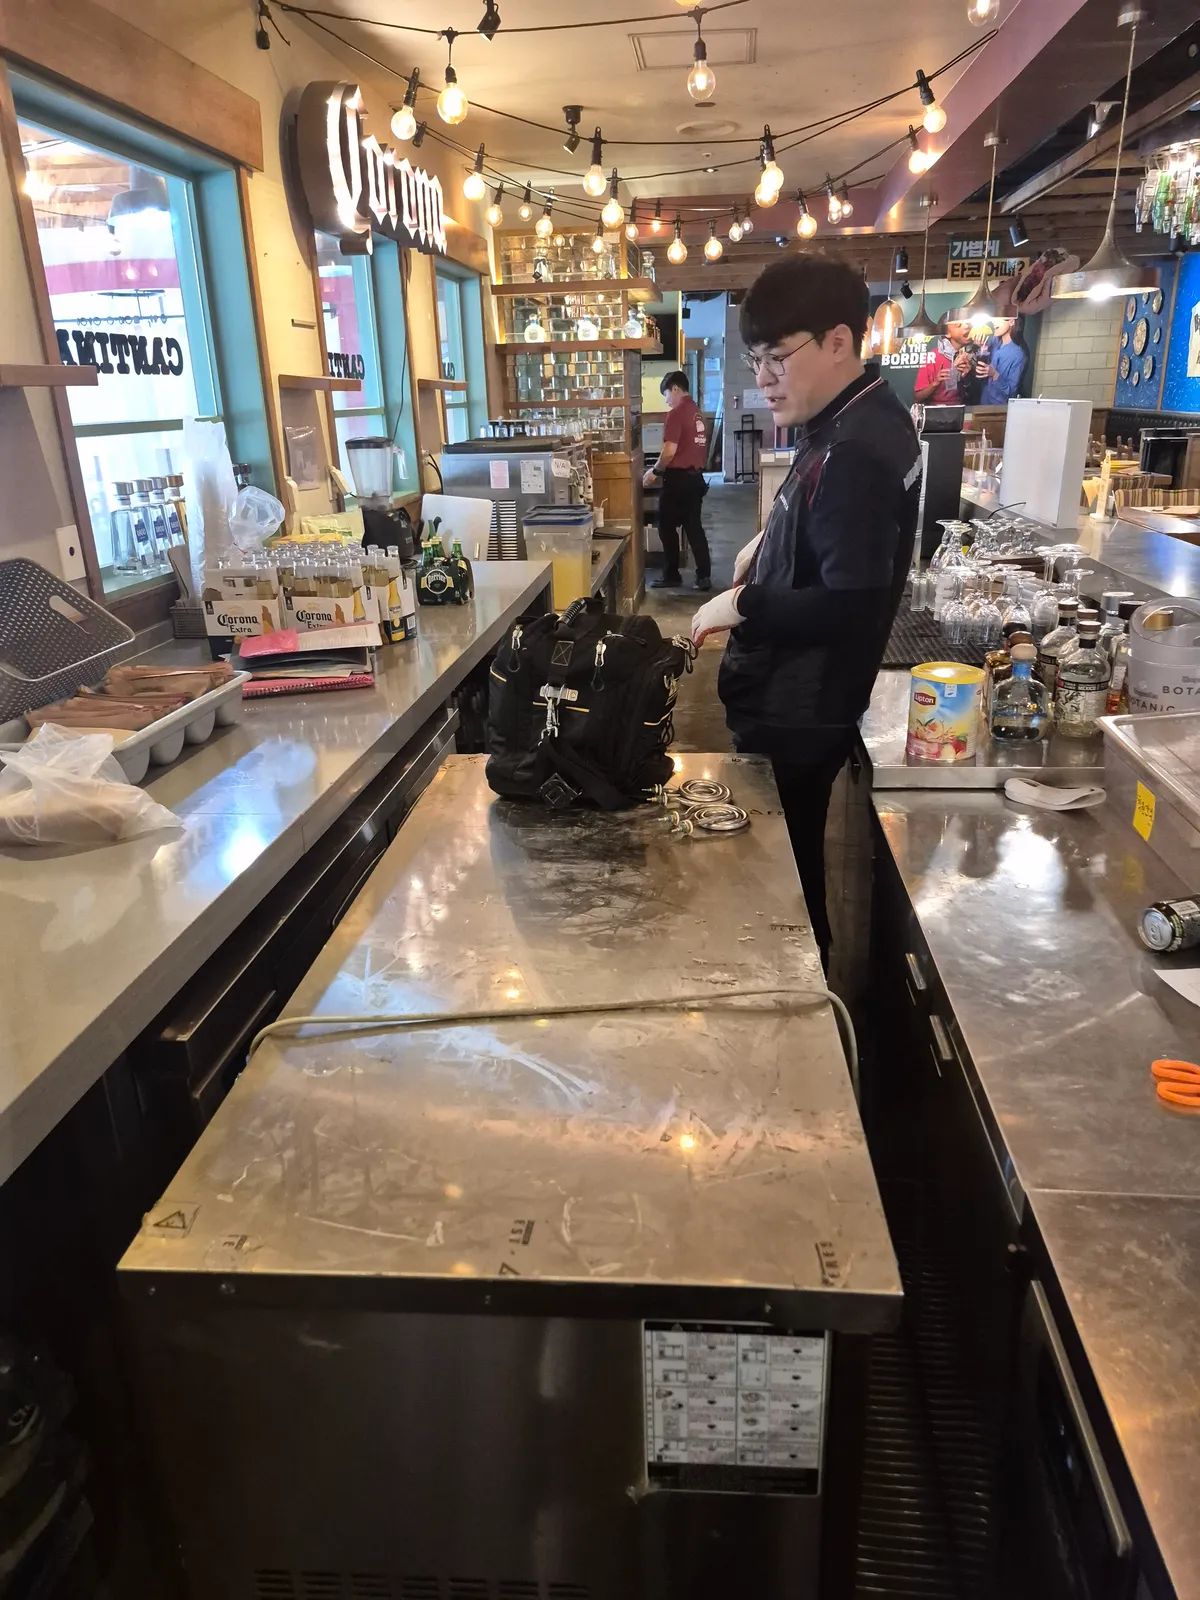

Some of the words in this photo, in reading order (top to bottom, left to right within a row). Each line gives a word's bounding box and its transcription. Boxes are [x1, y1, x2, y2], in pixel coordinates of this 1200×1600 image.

[952, 239, 1000, 258] 가볍게
[950, 261, 982, 278] 타코
[909, 343, 928, 353] THE
[881, 351, 937, 366] BORDER
[217, 613, 261, 628] Corona
[295, 610, 334, 624] Corona
[230, 625, 253, 634] Extra
[914, 693, 934, 704] Lipton
